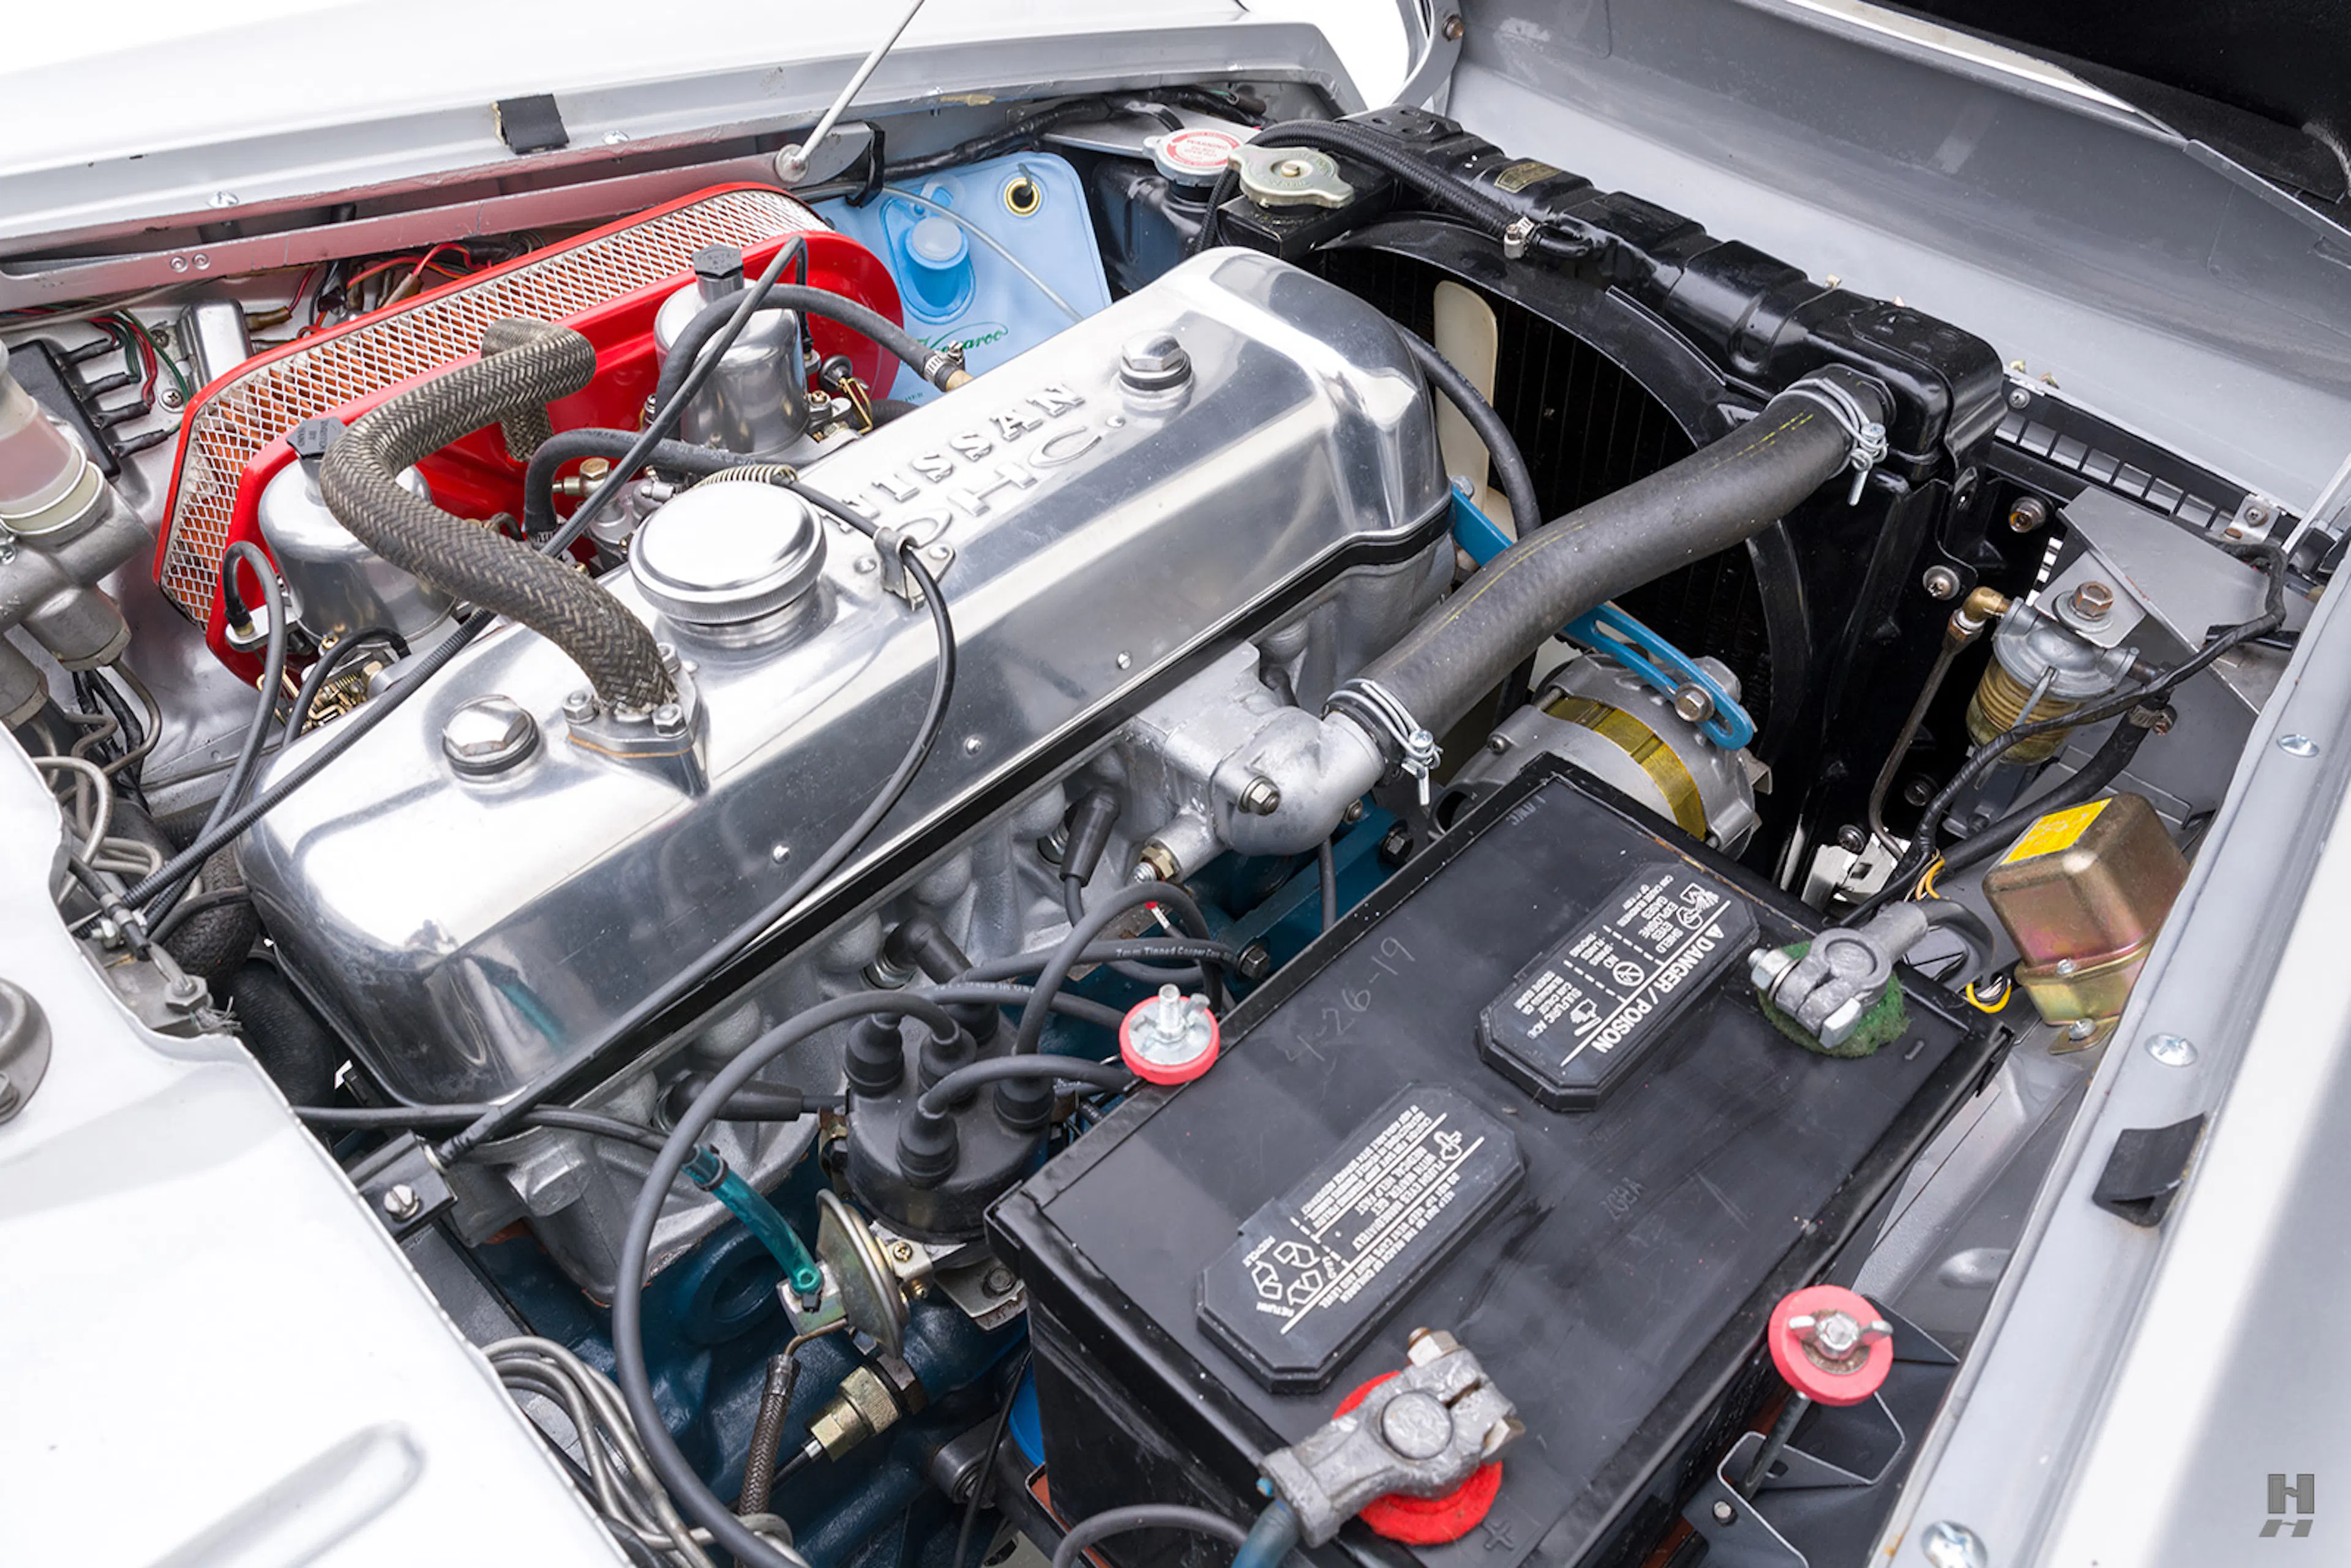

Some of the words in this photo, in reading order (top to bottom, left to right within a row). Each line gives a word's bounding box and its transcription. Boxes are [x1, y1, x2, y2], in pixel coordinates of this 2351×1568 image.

[820, 381, 1086, 534] NISSAN
[1144, 947, 1176, 956] Tinned
[1652, 935, 1715, 993] DANGER
[1543, 986, 1583, 1024] SULFURIC
[1590, 997, 1652, 1053] POISON
